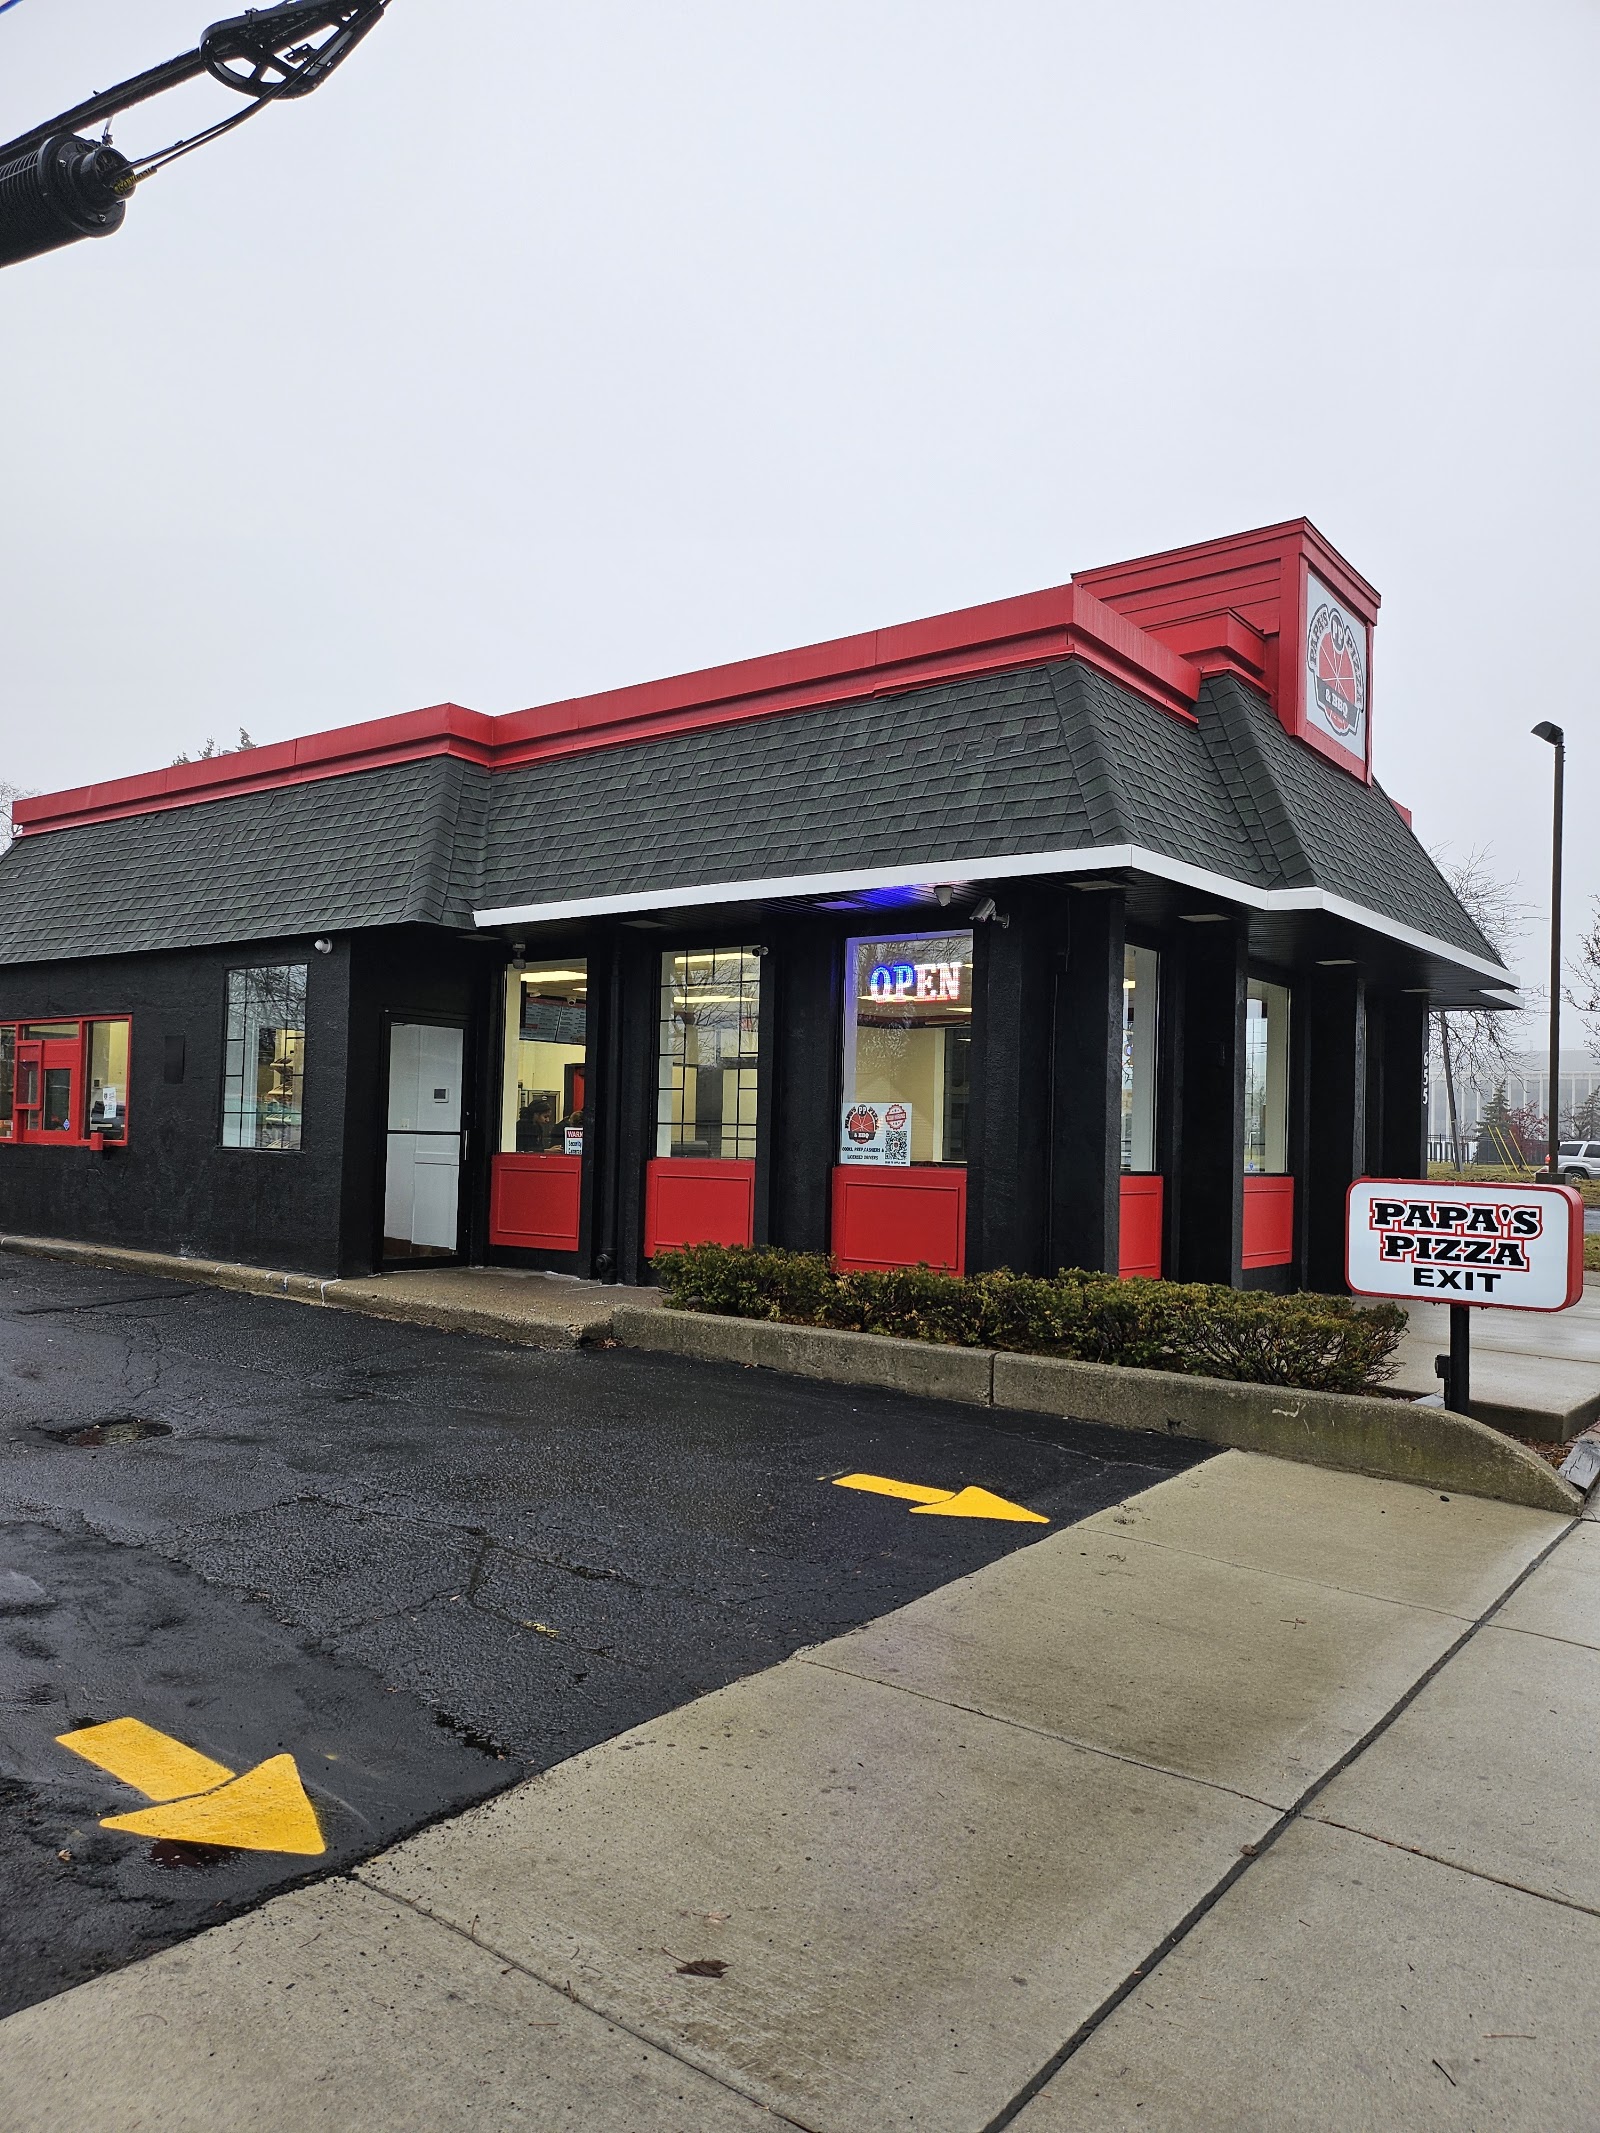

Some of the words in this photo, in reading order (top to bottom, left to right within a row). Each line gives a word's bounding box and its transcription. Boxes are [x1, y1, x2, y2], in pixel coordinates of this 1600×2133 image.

[1310, 610, 1329, 667] PAPA'S
[1332, 619, 1345, 646] PP
[1345, 632, 1362, 705] PIZZA
[1325, 688, 1332, 704] &
[1331, 692, 1348, 719] BBQ
[869, 961, 962, 1004] OPEN
[858, 1106, 868, 1115] PP
[1373, 1202, 1539, 1236] PAPA'S
[1384, 1234, 1525, 1267] PIZZA
[1413, 1267, 1502, 1293] EXIT
